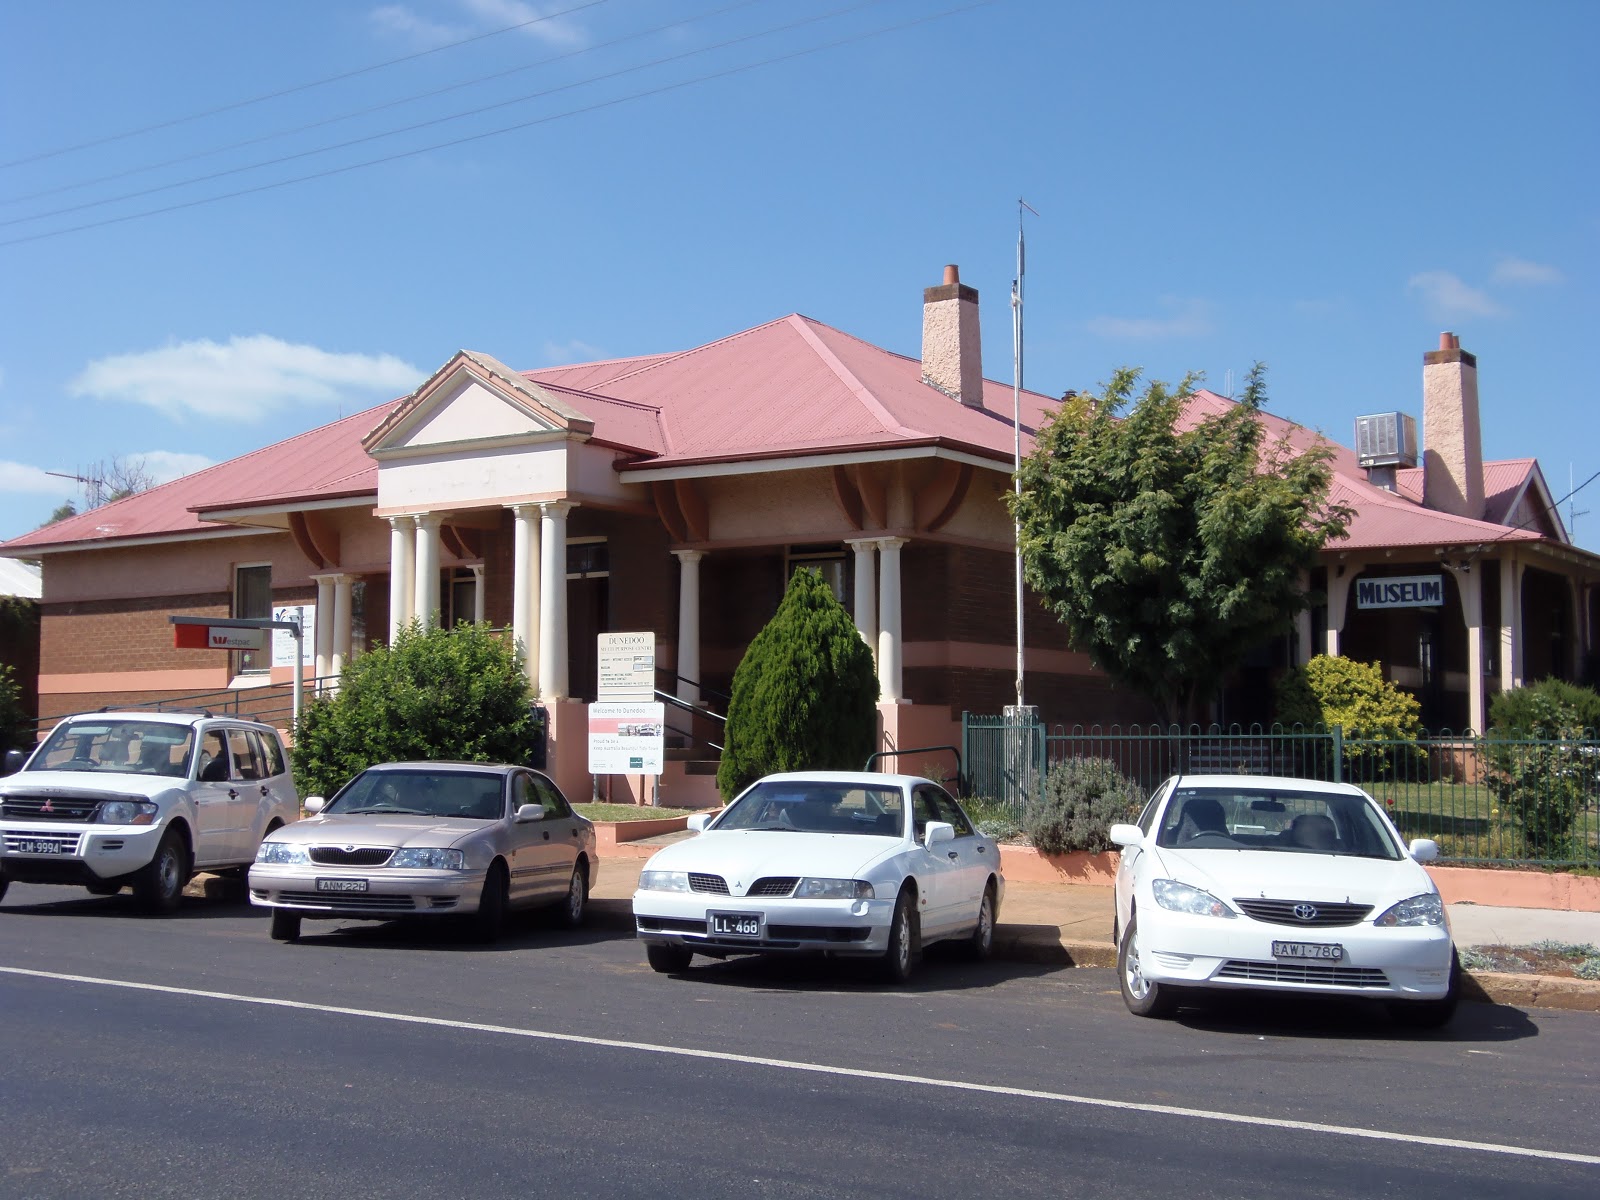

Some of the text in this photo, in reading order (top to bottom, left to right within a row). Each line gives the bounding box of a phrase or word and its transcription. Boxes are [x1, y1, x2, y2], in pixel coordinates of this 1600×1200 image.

[1359, 582, 1440, 604] MUSEUM
[212, 636, 250, 646] Westpac
[609, 636, 645, 645] DUNEDOO
